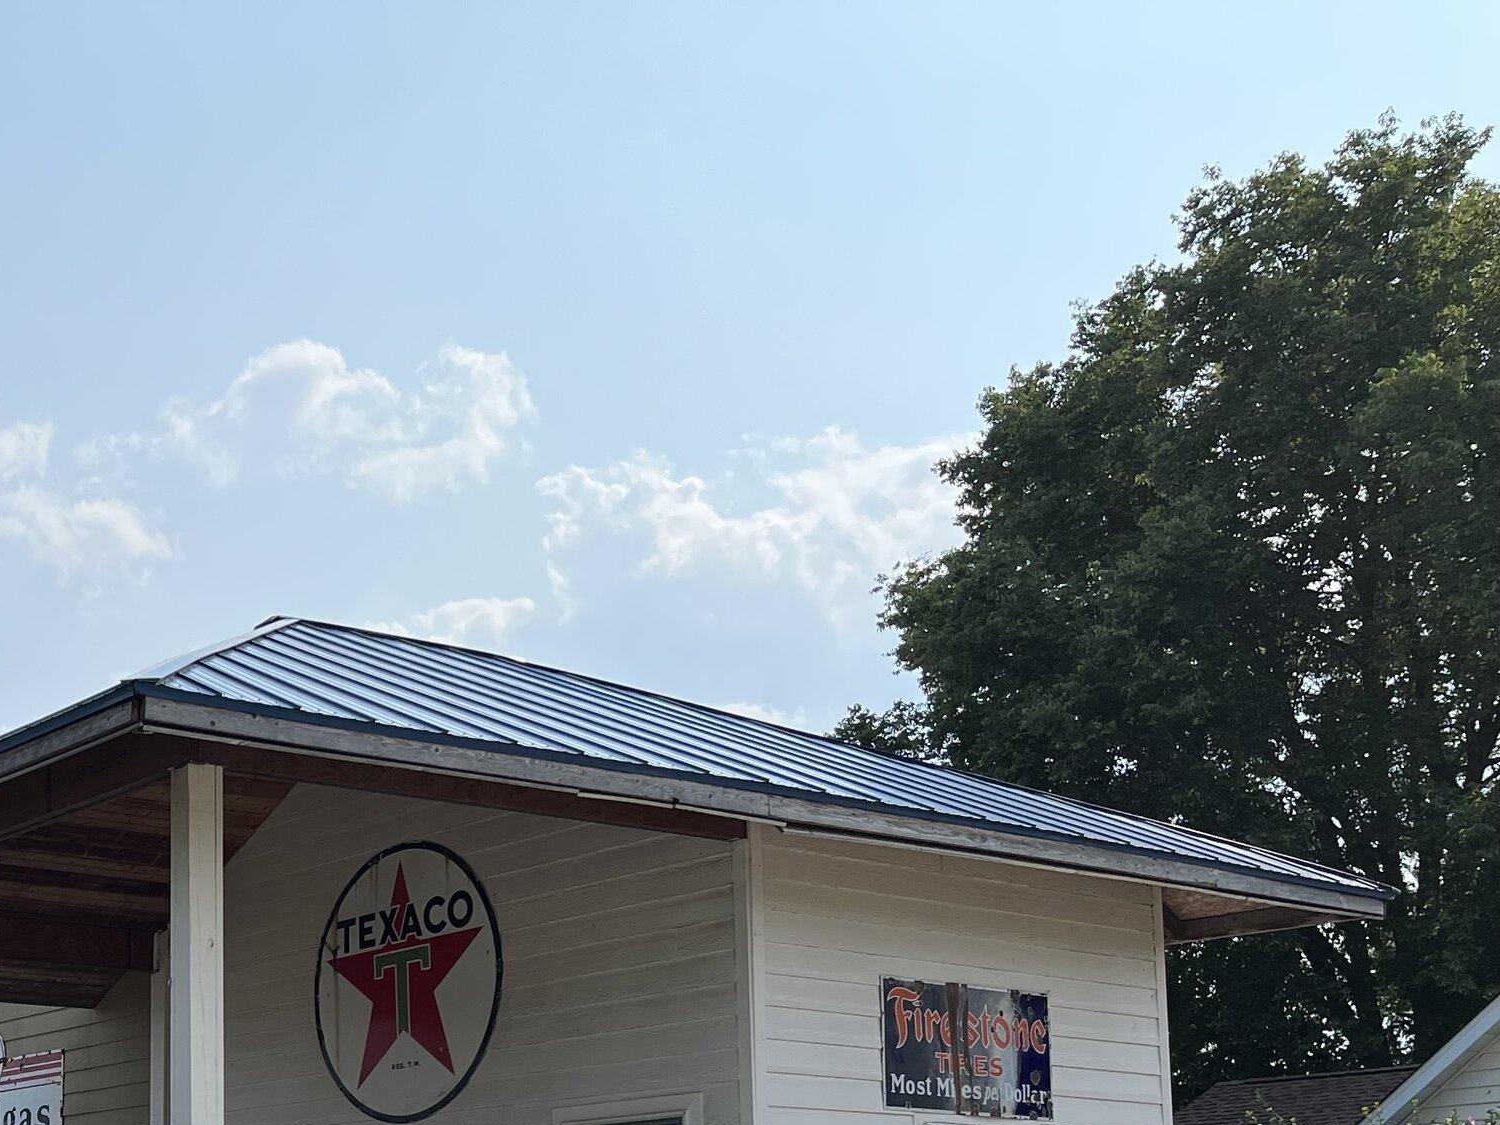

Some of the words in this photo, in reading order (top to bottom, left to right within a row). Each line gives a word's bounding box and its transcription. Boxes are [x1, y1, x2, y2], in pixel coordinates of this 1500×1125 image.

[336, 889, 474, 954] TEXACO
[372, 943, 432, 1036] T
[890, 1073, 933, 1096] Most
